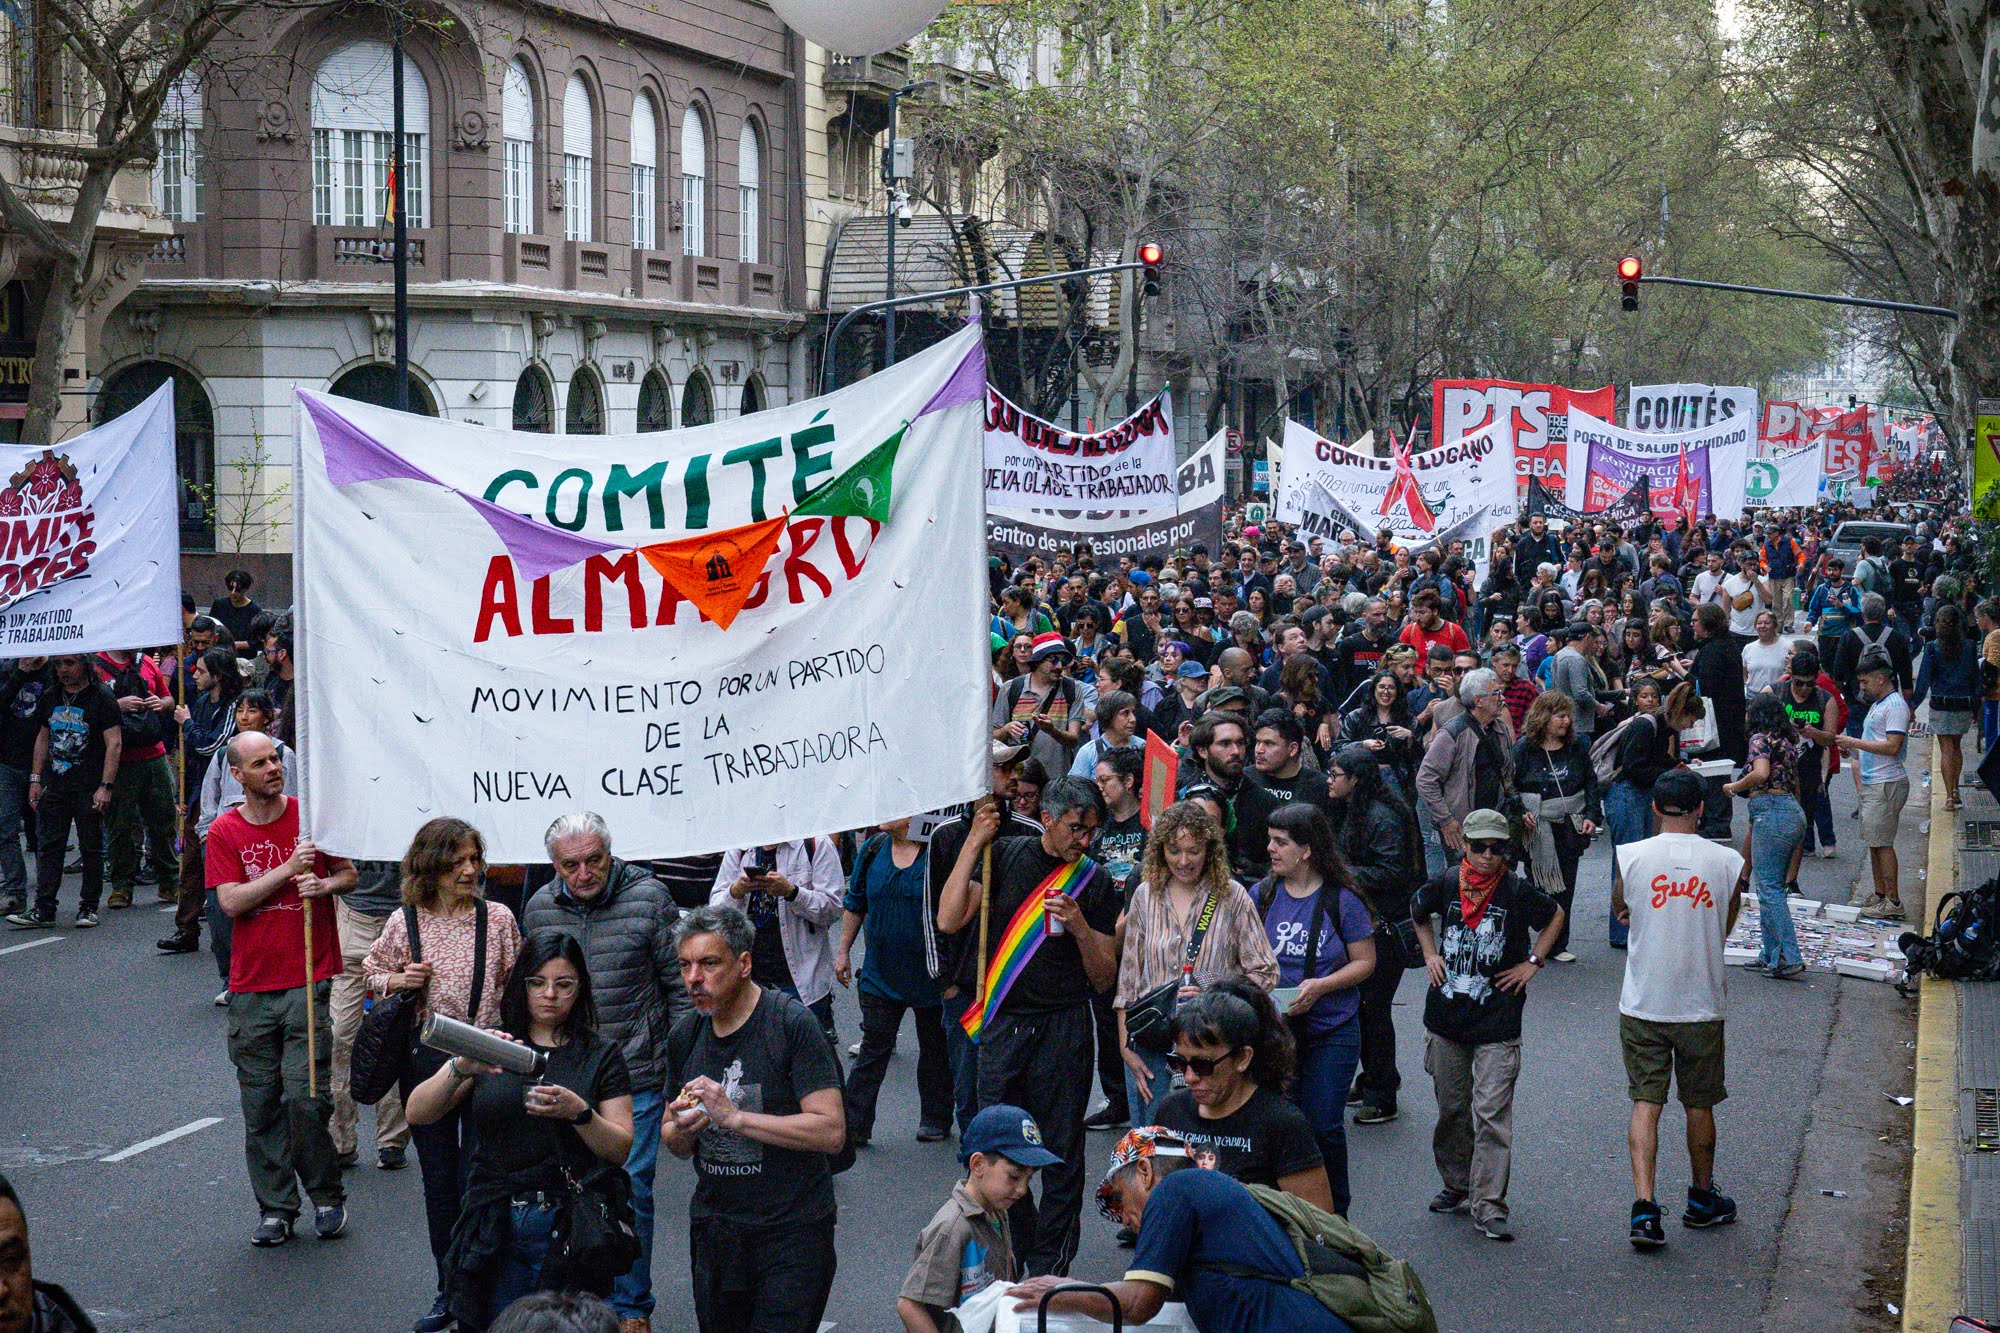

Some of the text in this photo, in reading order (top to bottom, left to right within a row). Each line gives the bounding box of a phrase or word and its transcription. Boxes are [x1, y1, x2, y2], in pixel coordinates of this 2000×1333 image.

[1443, 385, 1551, 450] PTS
[1417, 433, 1494, 471] LUGANO
[1573, 429, 1613, 449] POSTA
[1617, 438, 1632, 451] DE
[1637, 441, 1679, 454] SALUD
[1682, 441, 1691, 452] Y
[1695, 429, 1747, 451] CUIDADO
[483, 408, 836, 532] COMITÉ
[1005, 455, 1021, 467] por
[1023, 457, 1034, 467] un
[1034, 456, 1111, 482] PARTIDO
[1114, 462, 1129, 472] de
[1619, 470, 1680, 488] VIETA
[1023, 471, 1073, 497] CLASE
[1074, 473, 1175, 500] TRABAJADOR
[1746, 497, 1768, 506] CABA
[986, 518, 1196, 557] Centro de rfesionales por
[1300, 509, 1360, 544] MAR
[10, 613, 26, 628] UN
[27, 608, 73, 627] PARTIDO
[8, 624, 84, 644] TRABAJADORA
[471, 644, 885, 713] MOVIMIENTO POR UN PARTIDO
[645, 713, 730, 753] DE LA
[472, 722, 887, 802] NUEVA CLASE TRABAJADORA
[921, 822, 938, 836] D
[708, 1163, 762, 1176] DIVISION
